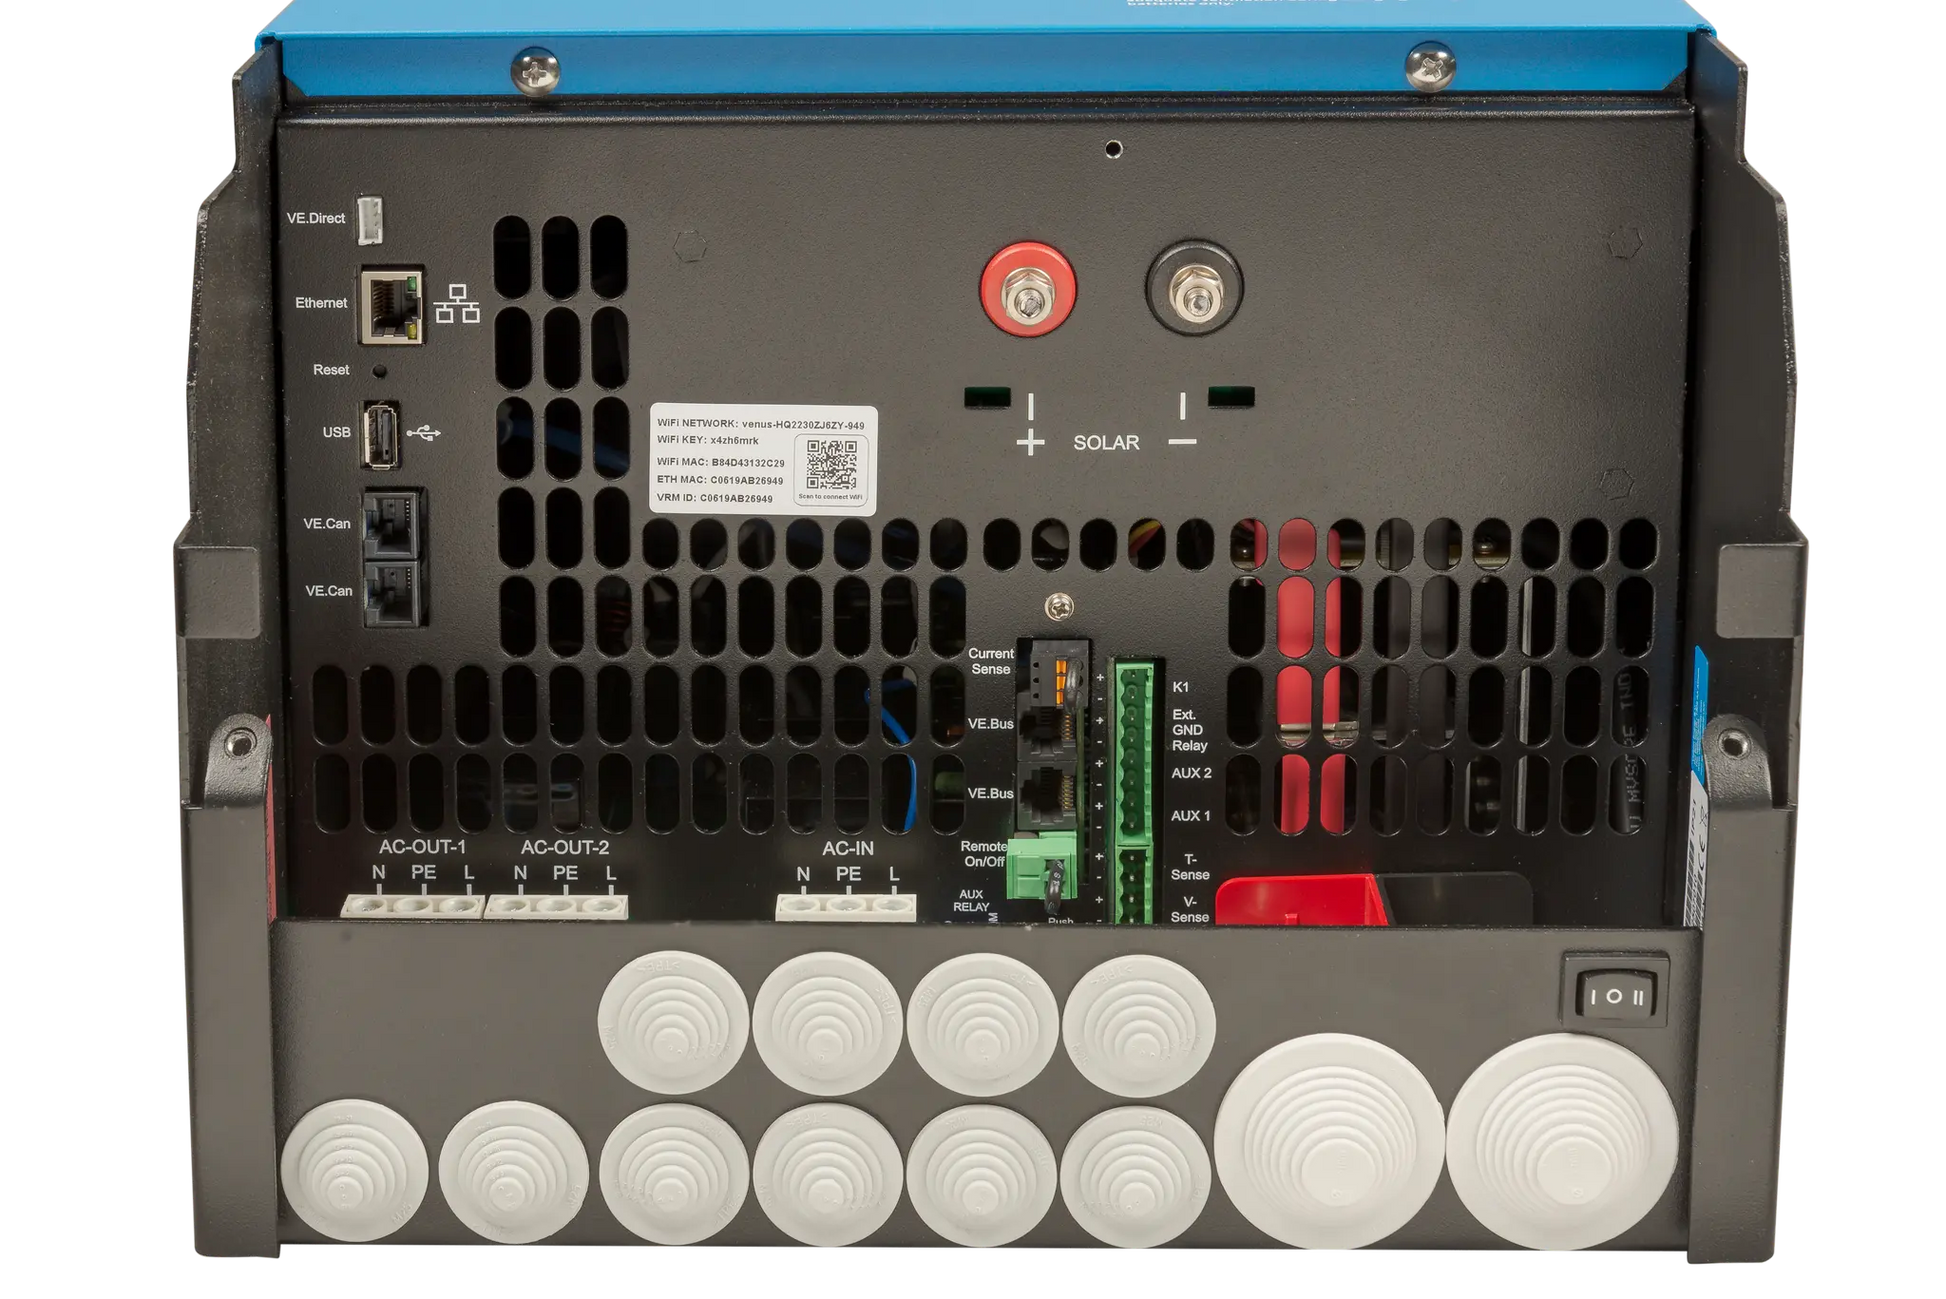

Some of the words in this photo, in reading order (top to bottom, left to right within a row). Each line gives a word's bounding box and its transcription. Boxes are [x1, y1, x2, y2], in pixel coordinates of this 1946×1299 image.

[286, 212, 346, 224] VE.Direct
[295, 296, 348, 309] Ethernet
[313, 363, 350, 376] Reset
[657, 418, 680, 427] WiFi
[682, 418, 739, 428] NETWORK:
[323, 426, 352, 438] USB
[656, 434, 680, 444] WiFi
[681, 435, 707, 444] KEY:
[710, 435, 759, 446] x4zh6mrk
[1073, 434, 1140, 451] SOLAR
[656, 457, 679, 466] WiFi
[681, 457, 709, 467] MAC:
[711, 457, 785, 468] B84D43132C29
[657, 474, 678, 484] ETH
[680, 475, 709, 484] MAC:
[710, 475, 784, 486] C0619AB26949
[656, 492, 681, 502] VRM
[682, 493, 697, 502] ID:
[699, 493, 773, 504] C0619AB26949
[303, 517, 351, 530] VE.Can
[305, 584, 353, 597] VE.Can
[968, 647, 1015, 659] Current
[971, 663, 1011, 675] Sense
[1173, 681, 1189, 693] K1
[1172, 708, 1197, 721] Ext.
[967, 717, 1015, 730] VE.Bus
[1172, 724, 1204, 736] GND
[1172, 739, 1209, 754] Relay
[1171, 767, 1201, 779] AUX
[1203, 767, 1212, 779] 2
[967, 787, 1015, 800] VE.Bus
[1170, 809, 1201, 822] AUX
[378, 839, 466, 855] AC-OUT-1
[520, 839, 610, 855] AC-OUT-2
[822, 840, 874, 856] AC-IN
[961, 840, 1008, 852] Remote
[964, 855, 1006, 868] On/Off
[372, 864, 386, 880] N
[411, 864, 437, 880] PE
[464, 864, 475, 880] L
[514, 864, 527, 880] N
[553, 865, 579, 881] PE
[606, 865, 618, 881] L
[796, 866, 810, 882] N
[836, 866, 862, 882] PE
[889, 866, 901, 882] L
[1171, 868, 1211, 881] Sense
[959, 889, 984, 899] AUX
[953, 901, 990, 912] RELAY
[1170, 911, 1210, 924] Sense
